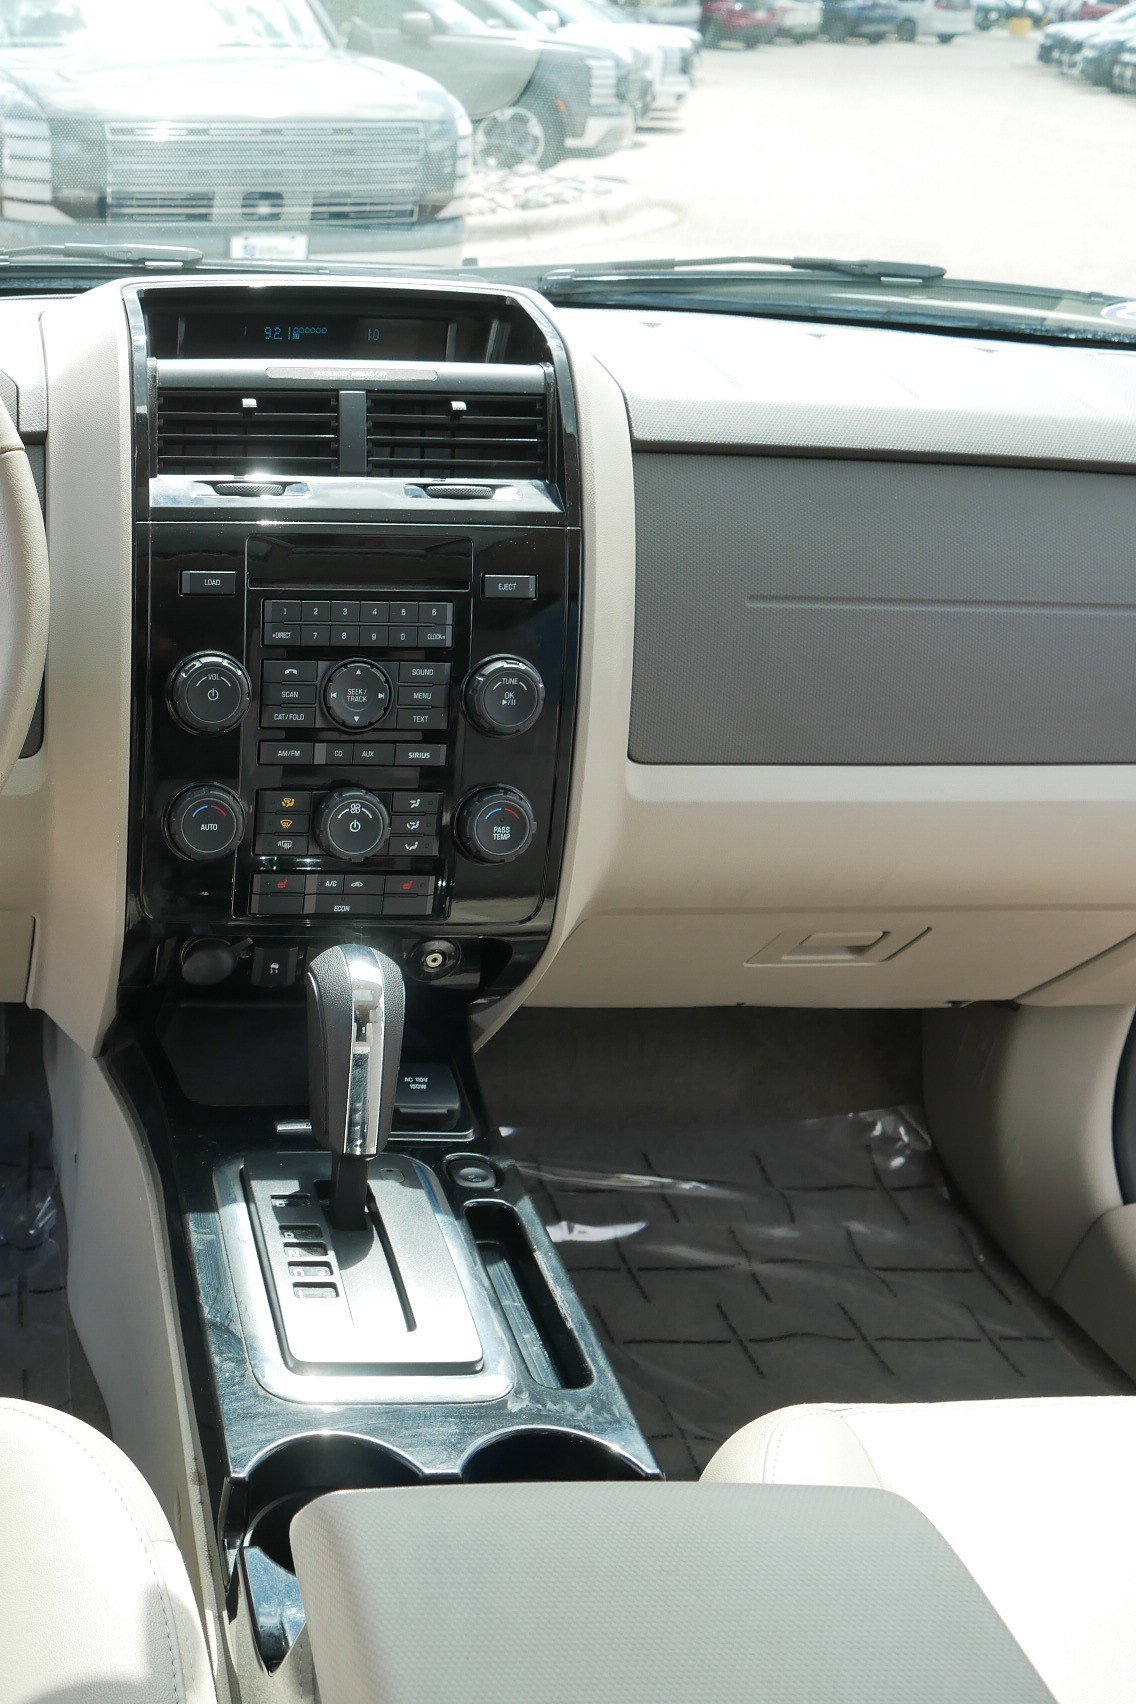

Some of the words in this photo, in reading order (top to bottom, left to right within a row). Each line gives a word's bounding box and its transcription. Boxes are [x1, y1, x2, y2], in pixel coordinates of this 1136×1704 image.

[498, 583, 517, 591] EJECT
[274, 713, 305, 721] CAT/FOLD
[200, 823, 218, 831] AUTO
[492, 833, 511, 841] TEMP
